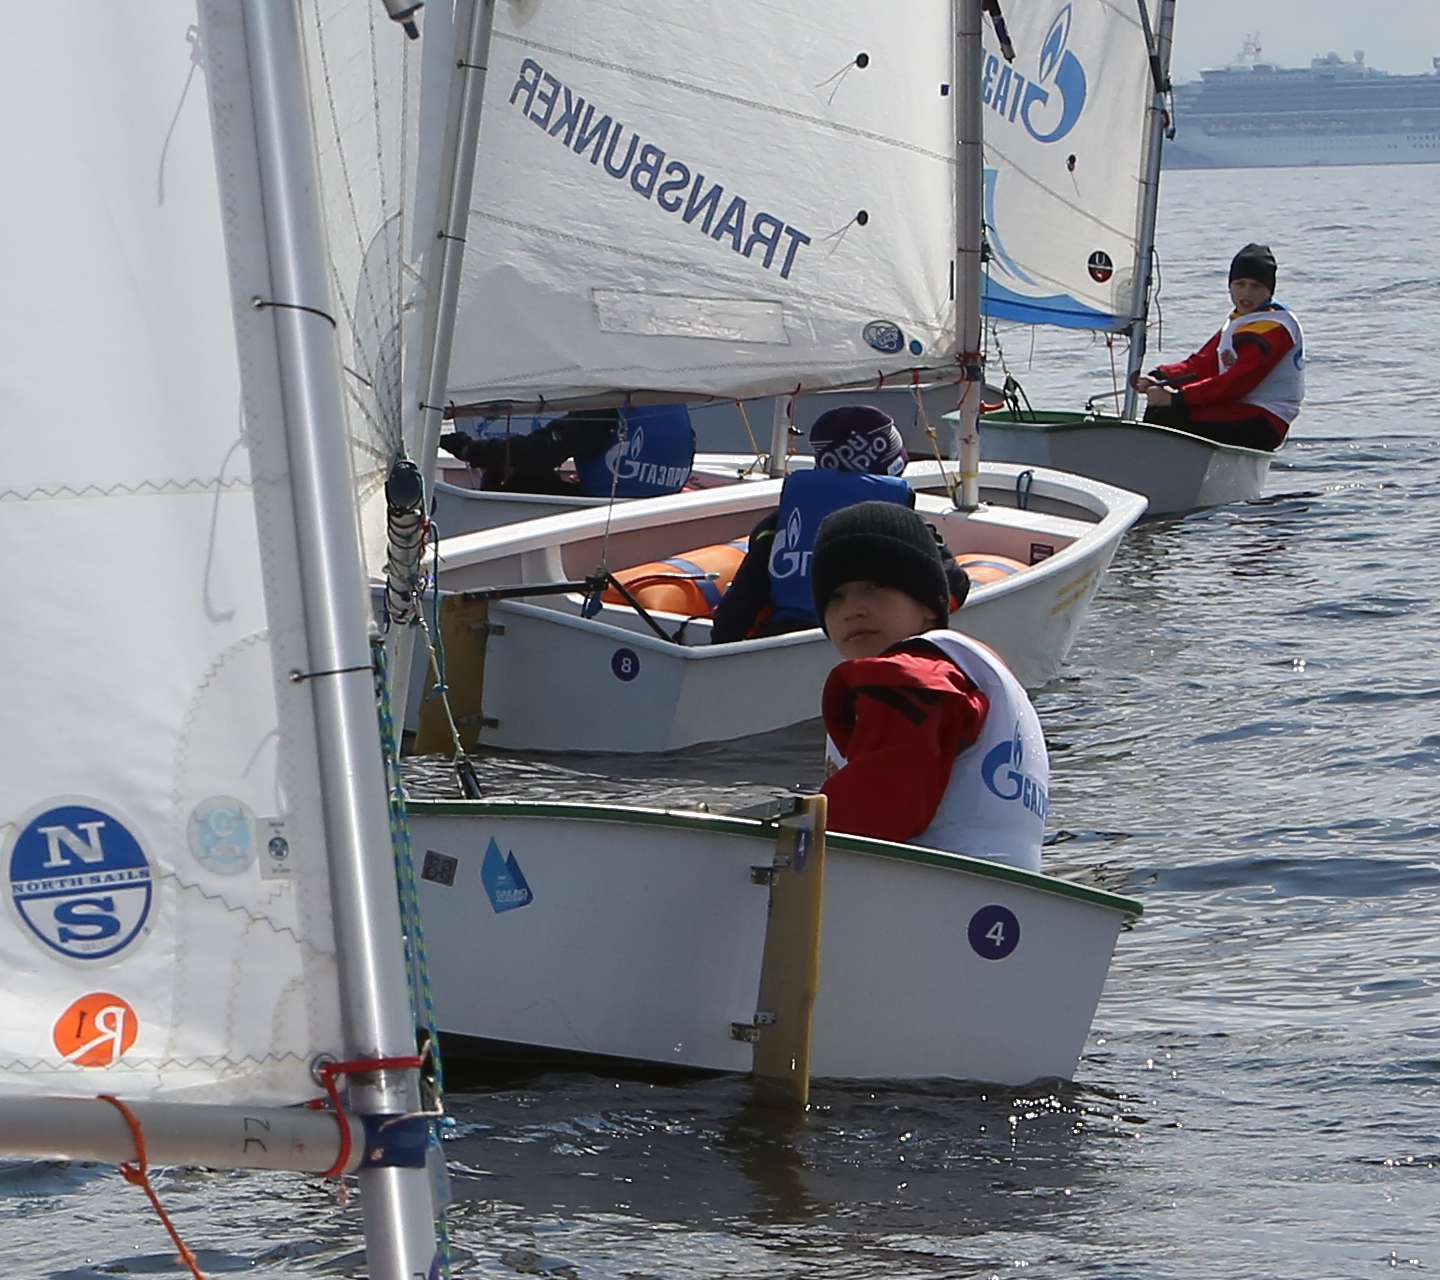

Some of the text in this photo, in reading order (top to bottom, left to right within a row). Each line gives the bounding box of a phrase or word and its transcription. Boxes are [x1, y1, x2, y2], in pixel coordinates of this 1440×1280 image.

[621, 657, 632, 673] 8
[37, 820, 106, 869] N
[11, 868, 151, 894] NORTH SAILS
[53, 896, 121, 943] S
[984, 920, 1005, 947] 4
